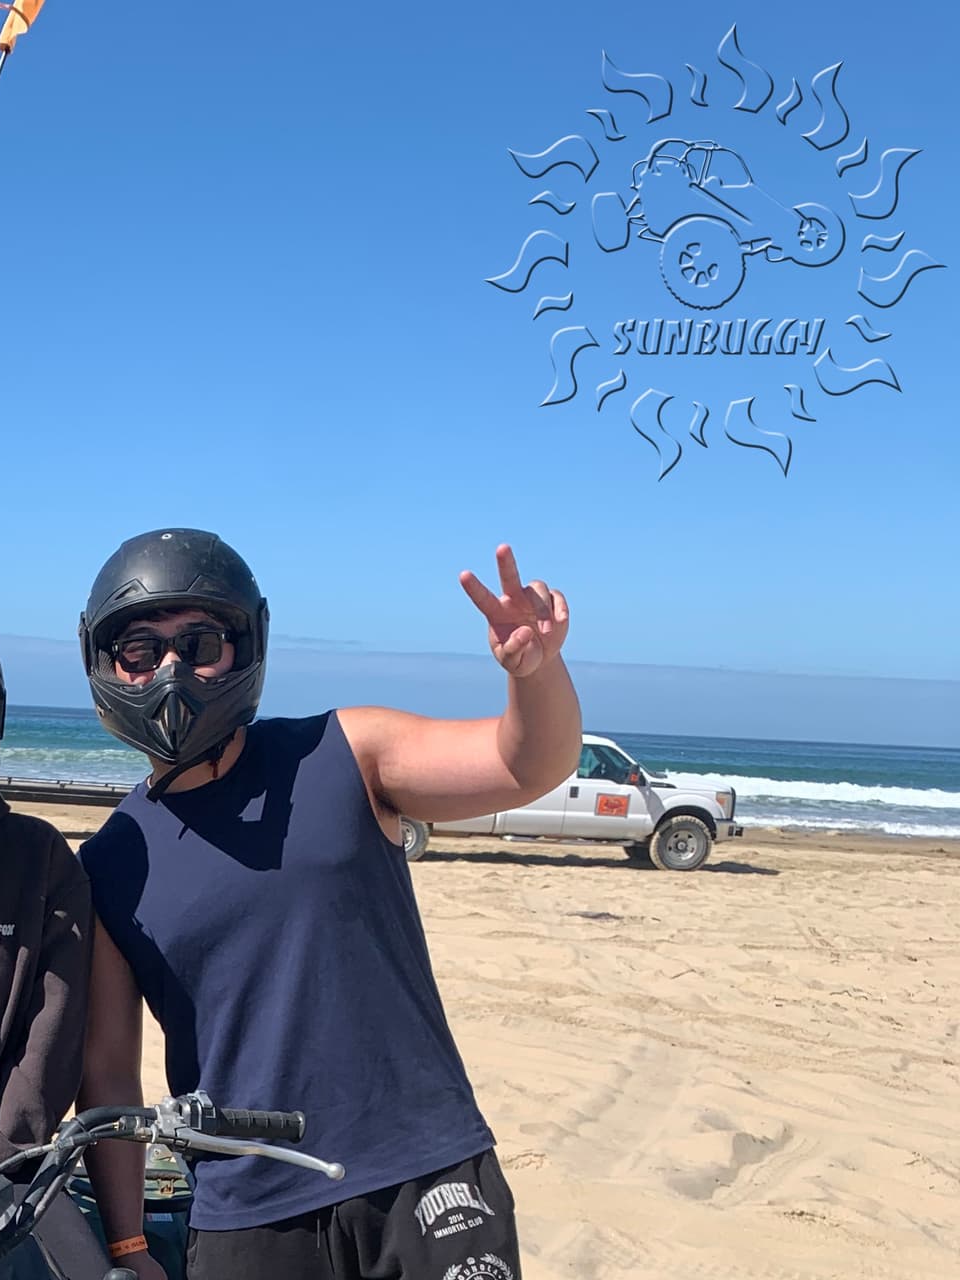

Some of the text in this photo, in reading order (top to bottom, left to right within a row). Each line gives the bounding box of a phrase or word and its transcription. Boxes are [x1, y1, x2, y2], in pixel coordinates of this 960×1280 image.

[433, 1215, 484, 1239] IMMORTAL CLUB
[447, 1212, 465, 1225] 2014
